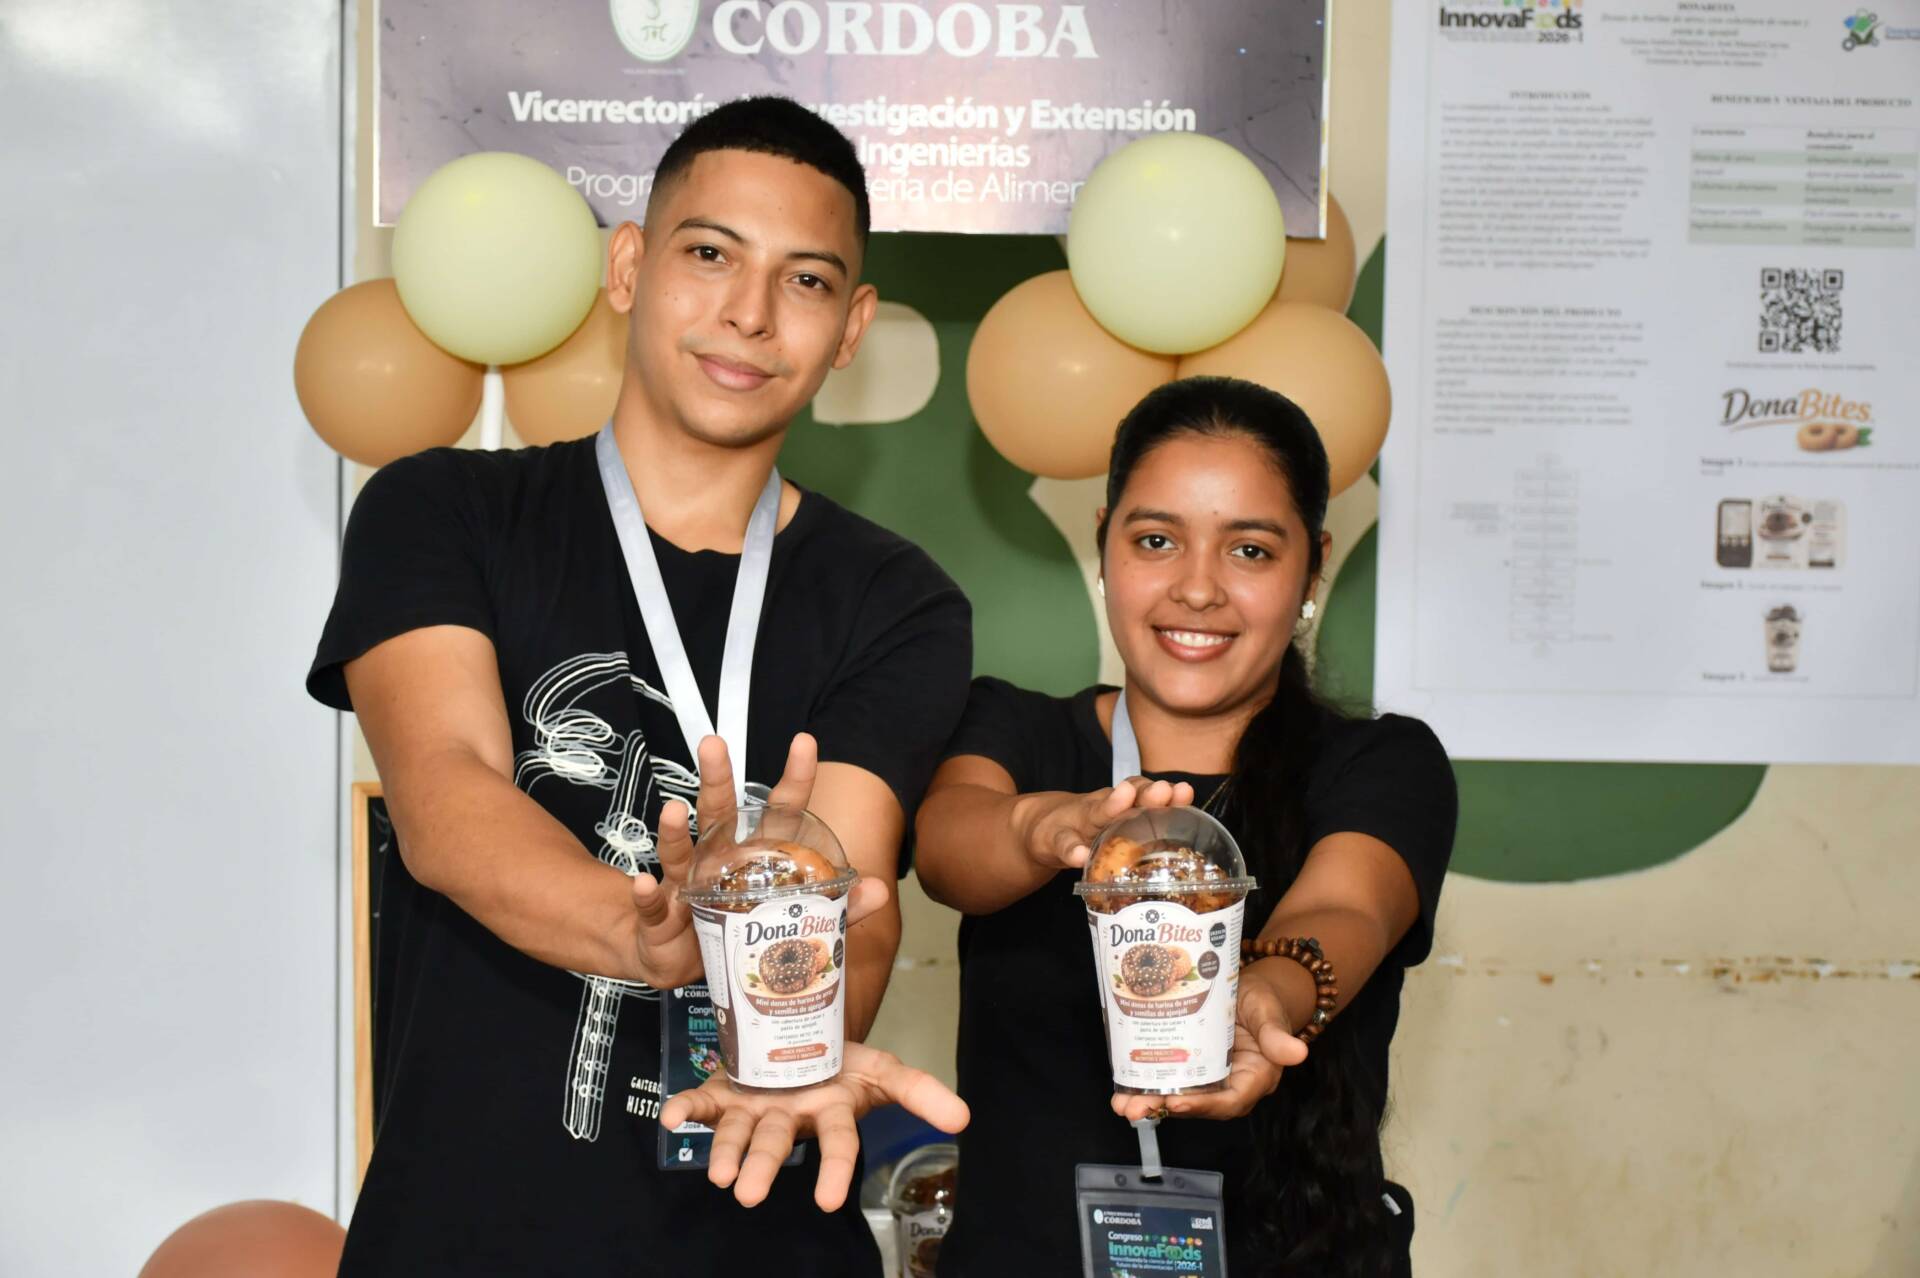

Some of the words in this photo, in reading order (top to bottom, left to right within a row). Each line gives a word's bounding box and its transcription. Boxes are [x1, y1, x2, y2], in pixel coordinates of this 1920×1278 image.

[807, 96, 999, 136] vestigación
[1003, 105, 1026, 137] y
[1030, 99, 1196, 131] Extensión
[859, 135, 1031, 174] Ingenierías
[931, 170, 974, 202] de
[688, 1005, 715, 1016] Congr
[626, 1094, 660, 1119] HISTO
[1108, 1230, 1143, 1243] Congreso
